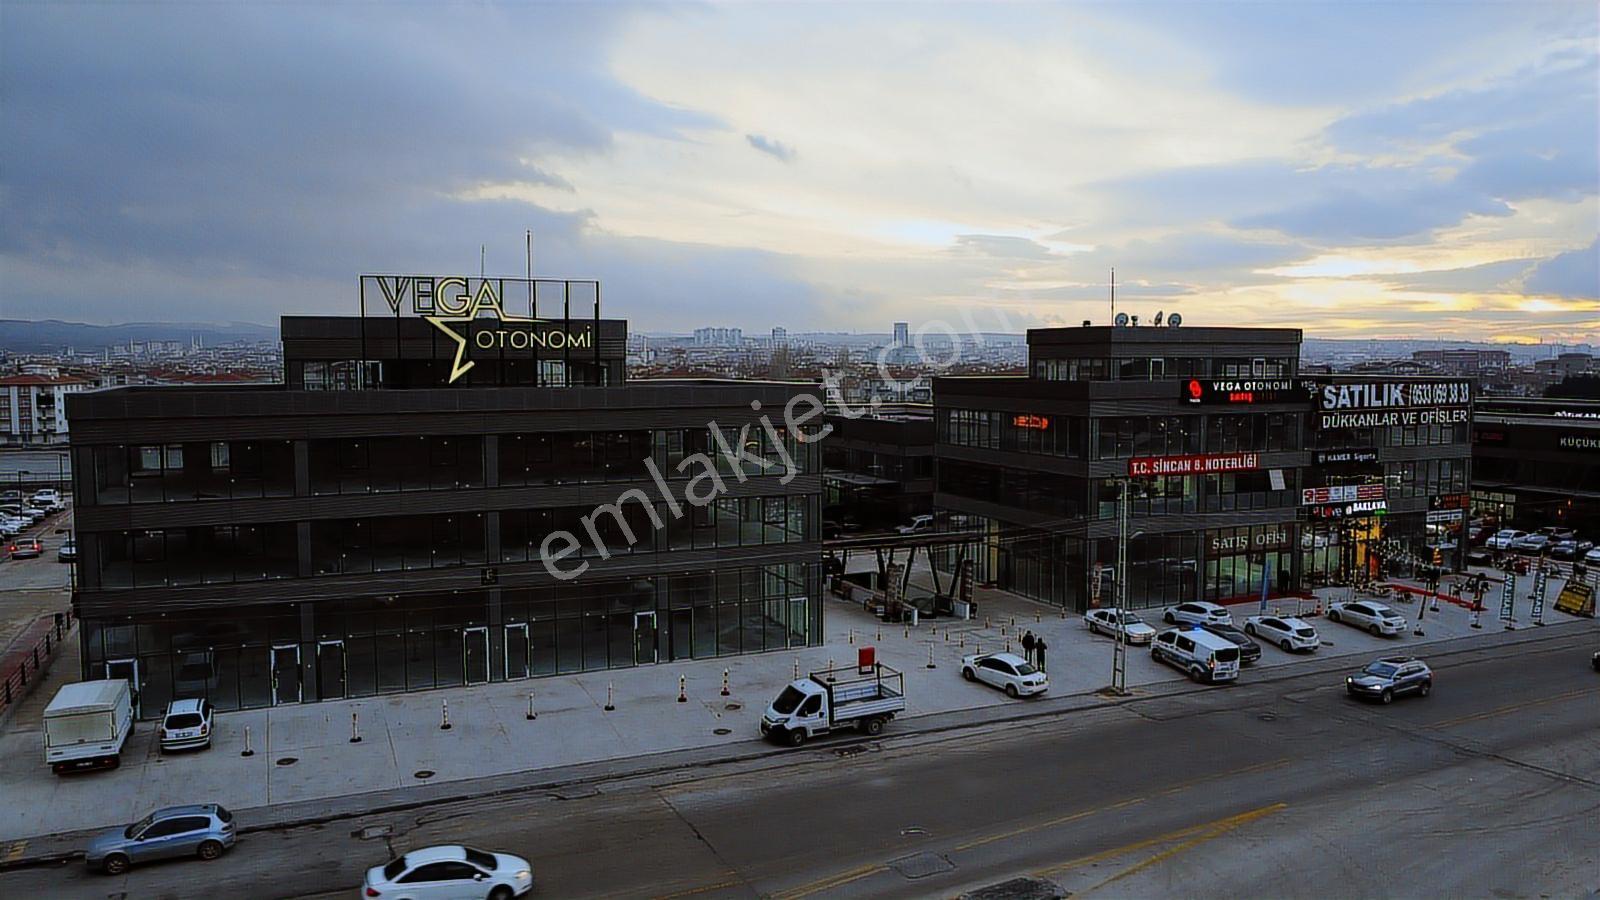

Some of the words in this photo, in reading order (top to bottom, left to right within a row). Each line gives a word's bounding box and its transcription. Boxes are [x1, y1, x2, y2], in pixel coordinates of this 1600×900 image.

[377, 276, 504, 315] VEGA
[476, 325, 592, 350] OTONOMİ
[1213, 381, 1240, 391] VEGA
[1323, 384, 1405, 409] SATILIK
[1323, 412, 1398, 429] DÜKKANLAR
[1402, 411, 1417, 425] VE
[1420, 407, 1468, 424] OFİSLER
[1132, 461, 1151, 474] T.C.
[1153, 458, 1191, 473] SİNCAN
[1206, 453, 1257, 470] NOTERLİĞİ
